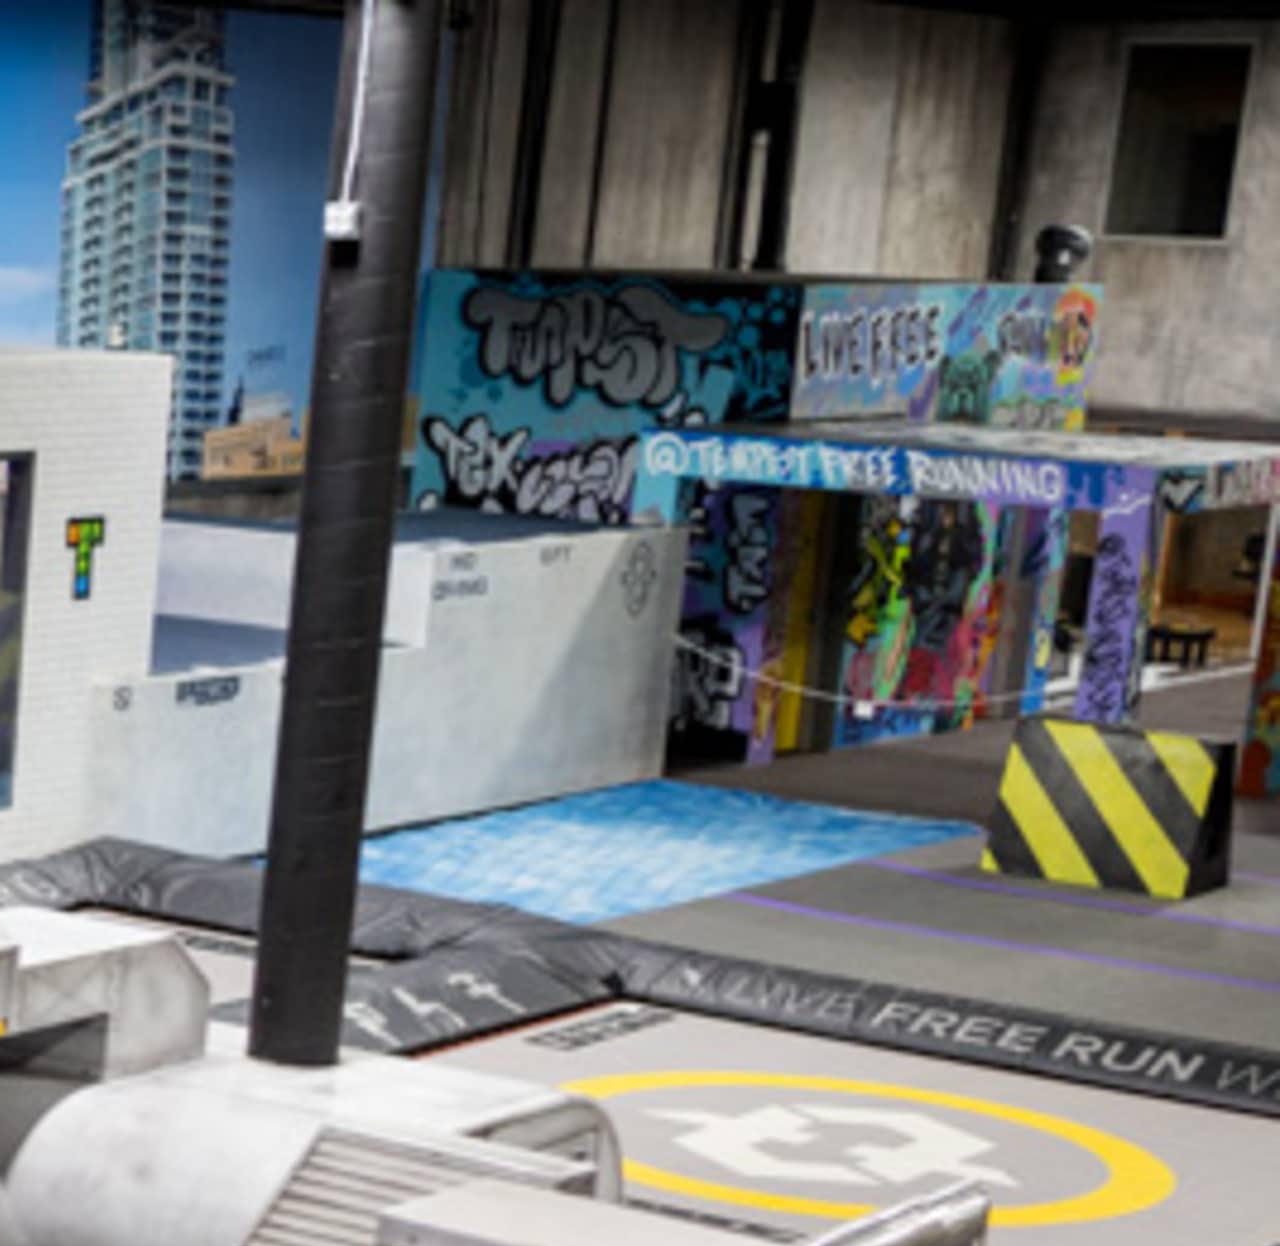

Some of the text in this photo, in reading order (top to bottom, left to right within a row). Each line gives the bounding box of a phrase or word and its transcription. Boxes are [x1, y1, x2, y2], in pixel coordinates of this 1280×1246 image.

[907, 450, 1063, 503] RUNNING
[870, 1001, 1050, 1056] FREE
[1051, 1031, 1206, 1084] RUN
[1215, 1058, 1280, 1096] W
